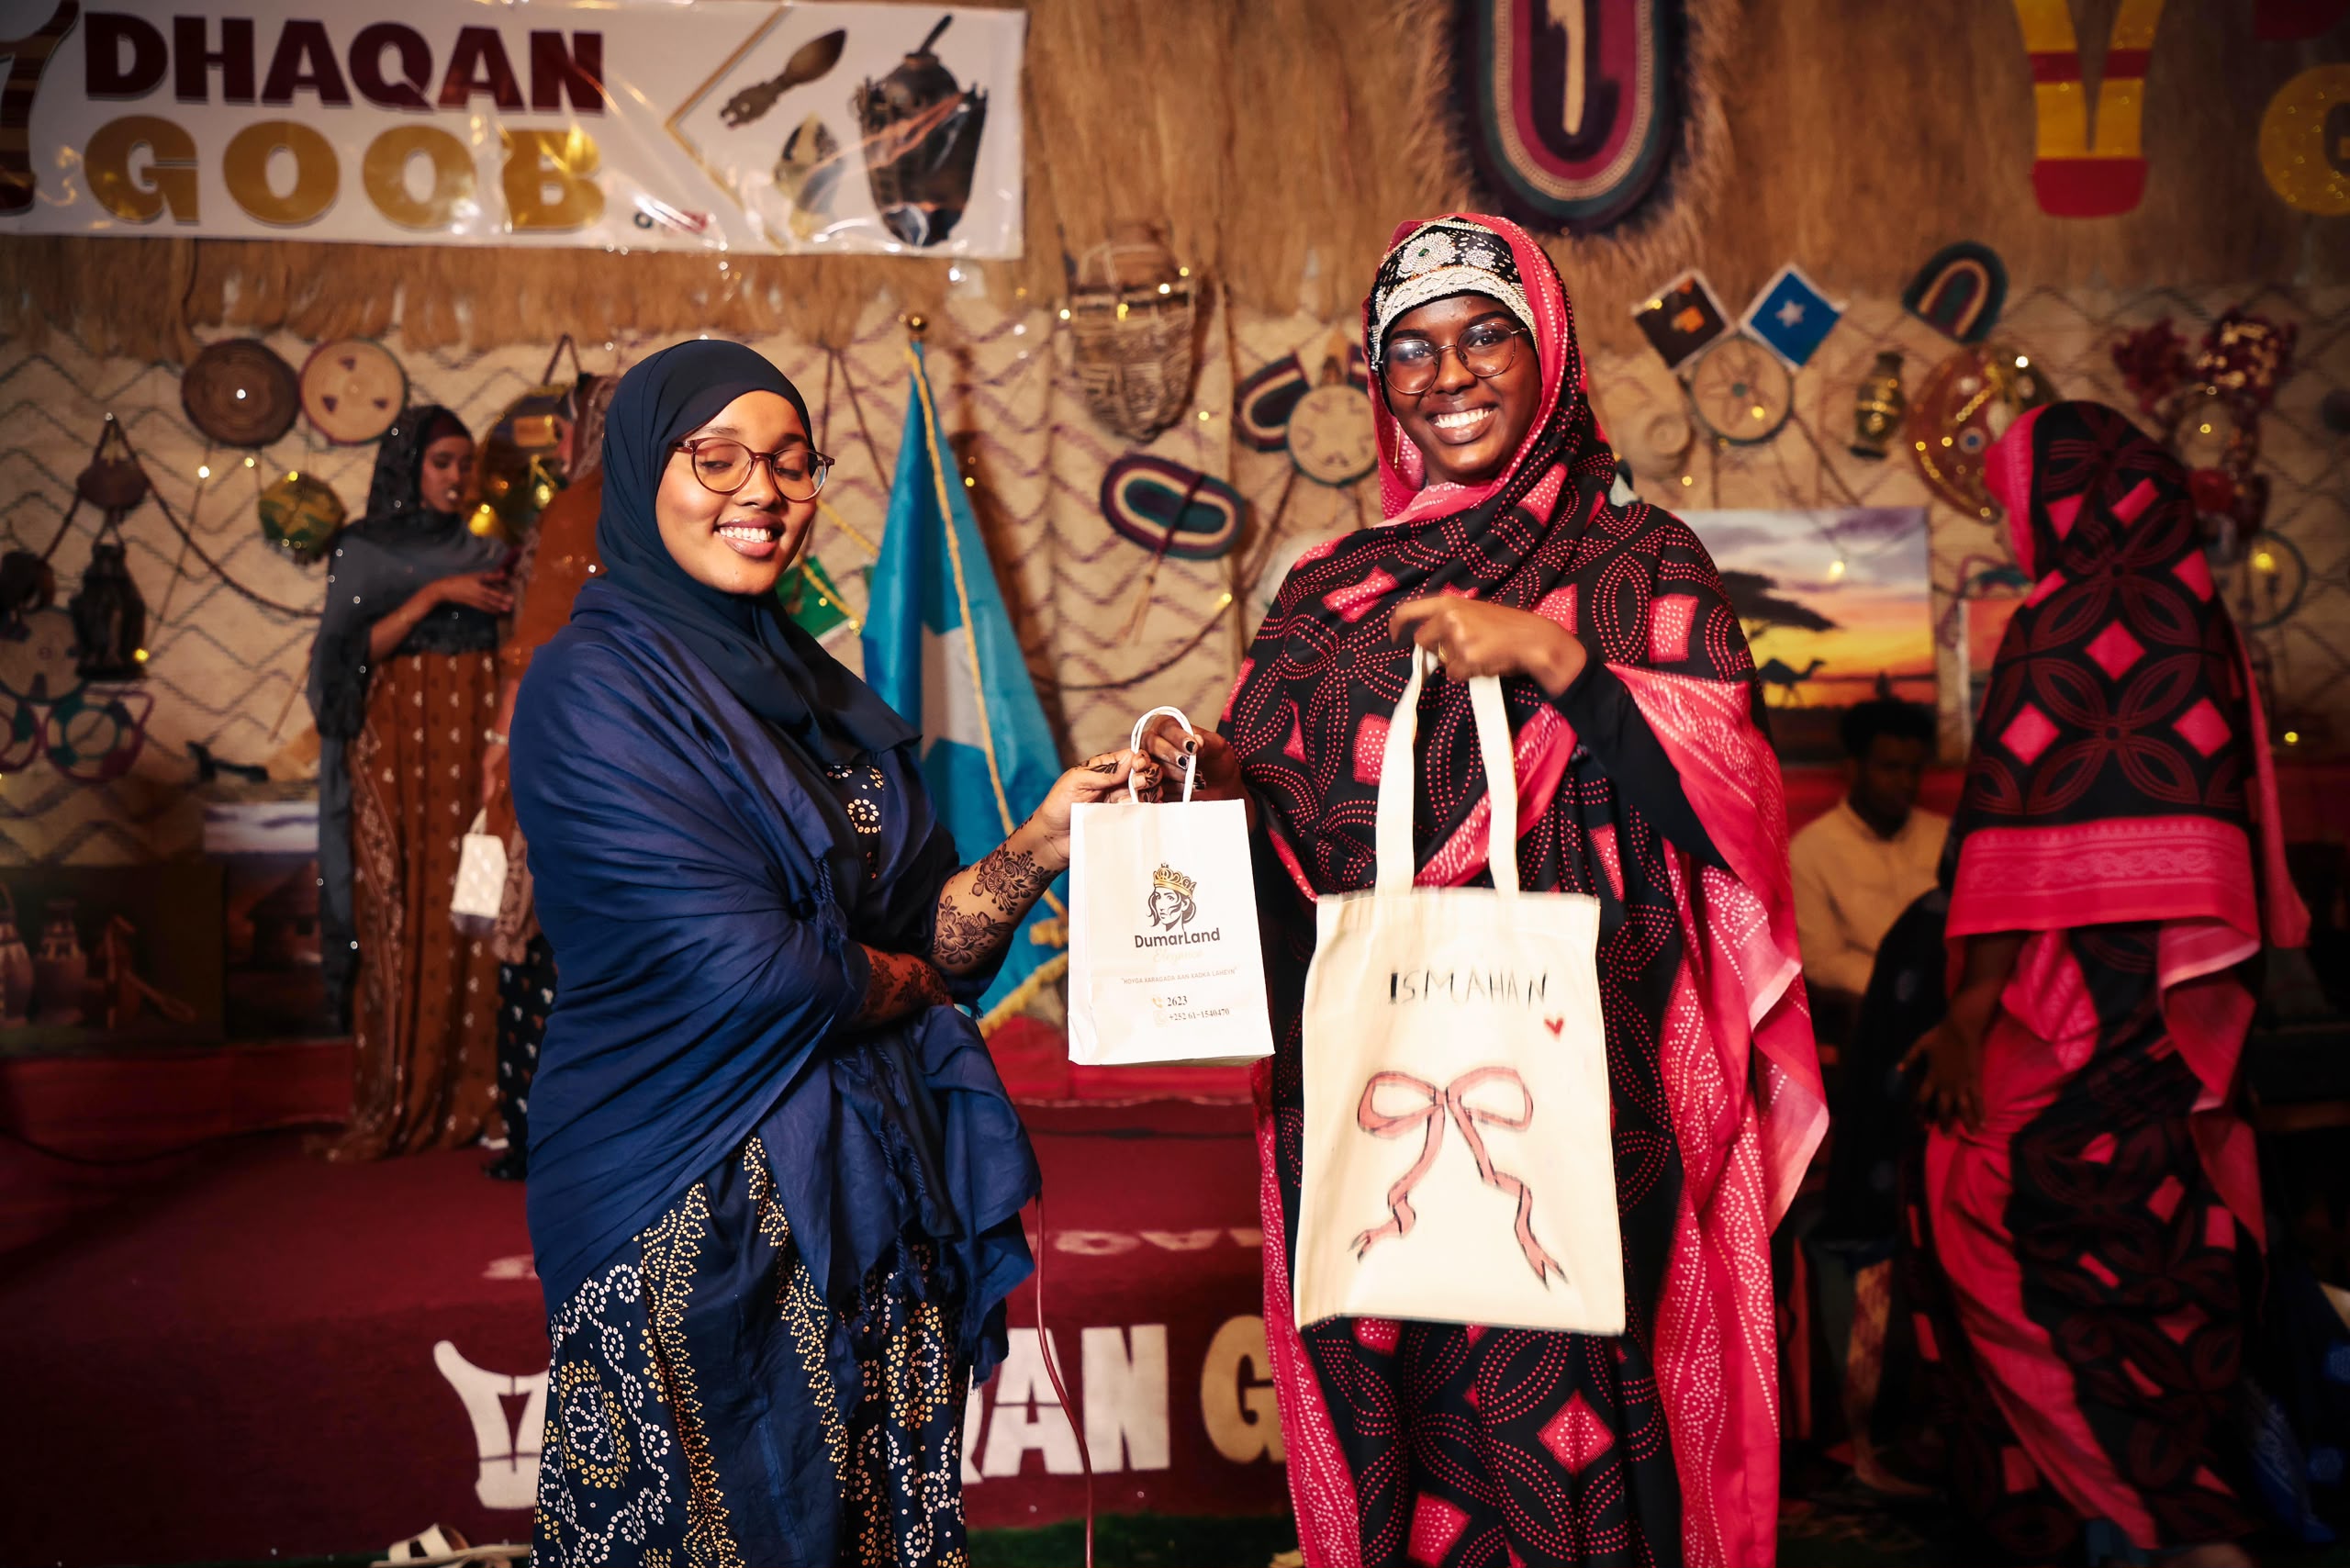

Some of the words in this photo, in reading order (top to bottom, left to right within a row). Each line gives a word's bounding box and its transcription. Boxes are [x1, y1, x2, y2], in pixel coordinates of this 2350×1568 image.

[84, 12, 605, 114] DHAQAN
[84, 116, 606, 232] GOOB
[1135, 927, 1221, 948] DumarLand
[1167, 995, 1188, 1007] 2623
[1388, 969, 1549, 1010] ISMAHAN
[1169, 1012, 1187, 1021] +252
